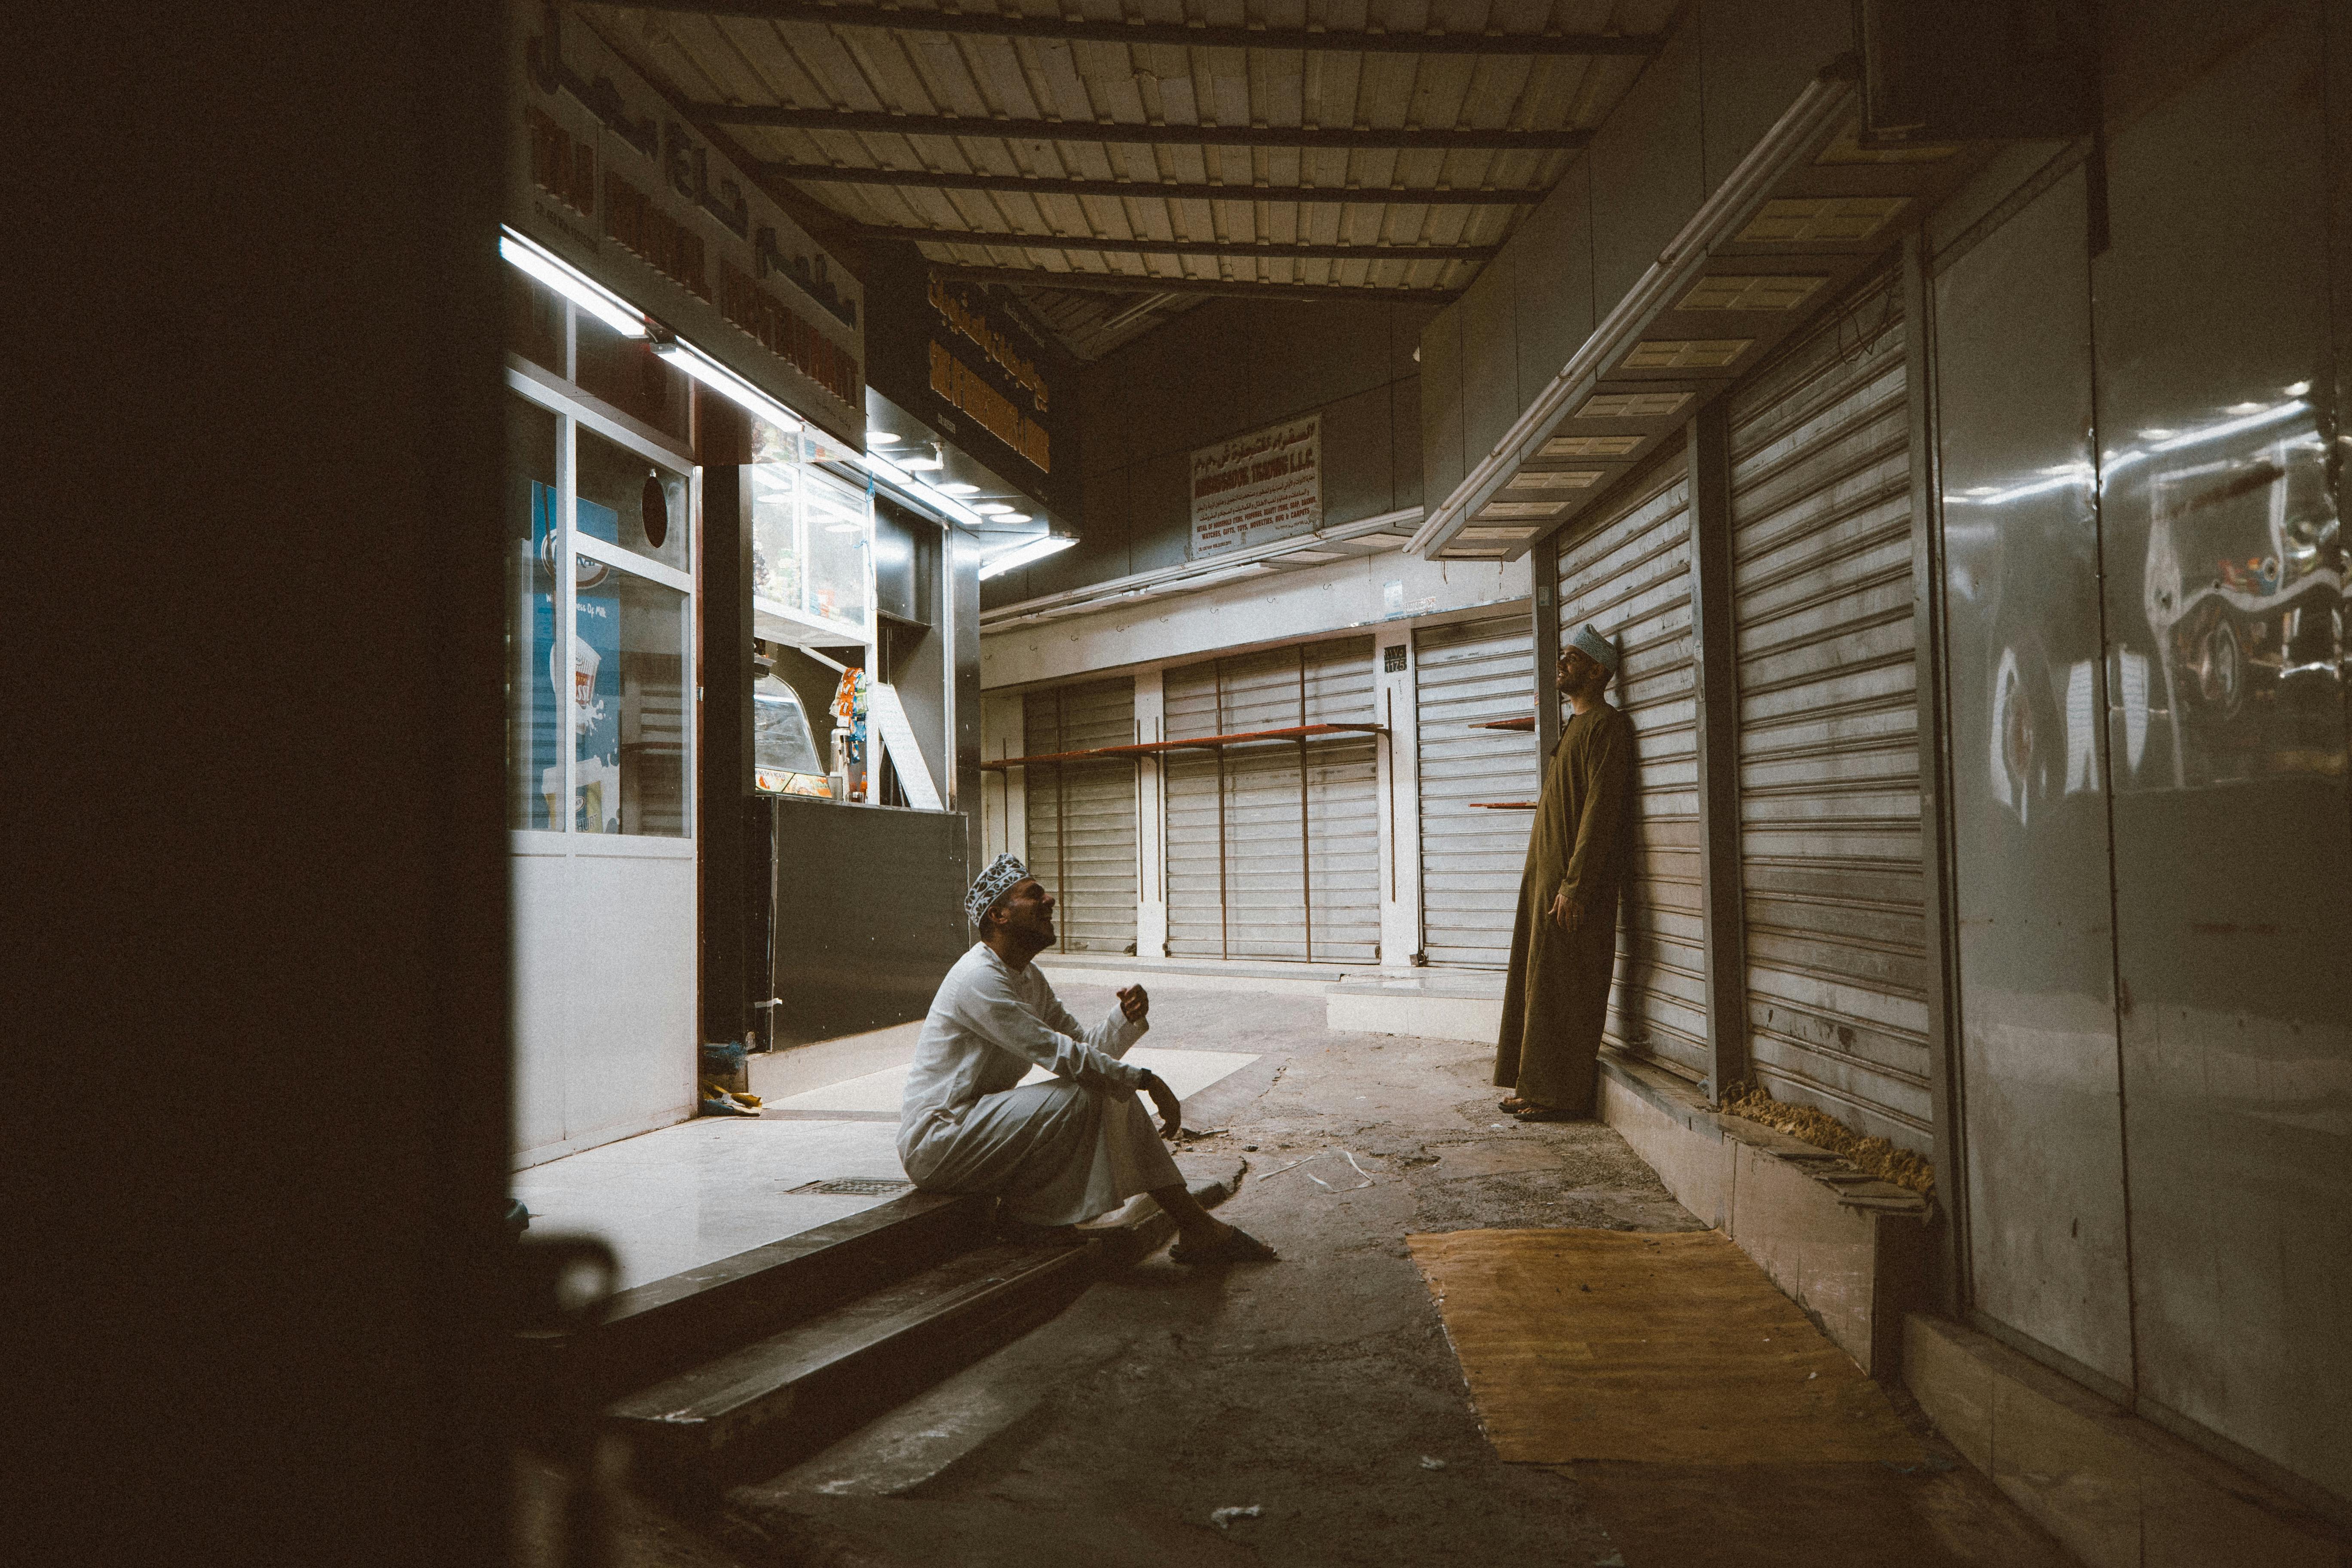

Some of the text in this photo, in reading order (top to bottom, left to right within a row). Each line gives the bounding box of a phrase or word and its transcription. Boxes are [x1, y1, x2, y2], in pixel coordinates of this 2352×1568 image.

[721, 257, 859, 408] RESTAURANT
[1202, 530, 1221, 540] WATCHES,
[1223, 527, 1235, 535] GIFTS,
[1250, 517, 1273, 529] NOVELTIES,
[1275, 514, 1284, 523] RUG
[1291, 507, 1310, 518] CARPETS
[1214, 518, 1232, 529] HOUSEHOLD
[1264, 507, 1276, 515] BEAUTY
[587, 603, 594, 618] Of
[595, 606, 606, 618] Milk
[1386, 660, 1405, 672] 1175
